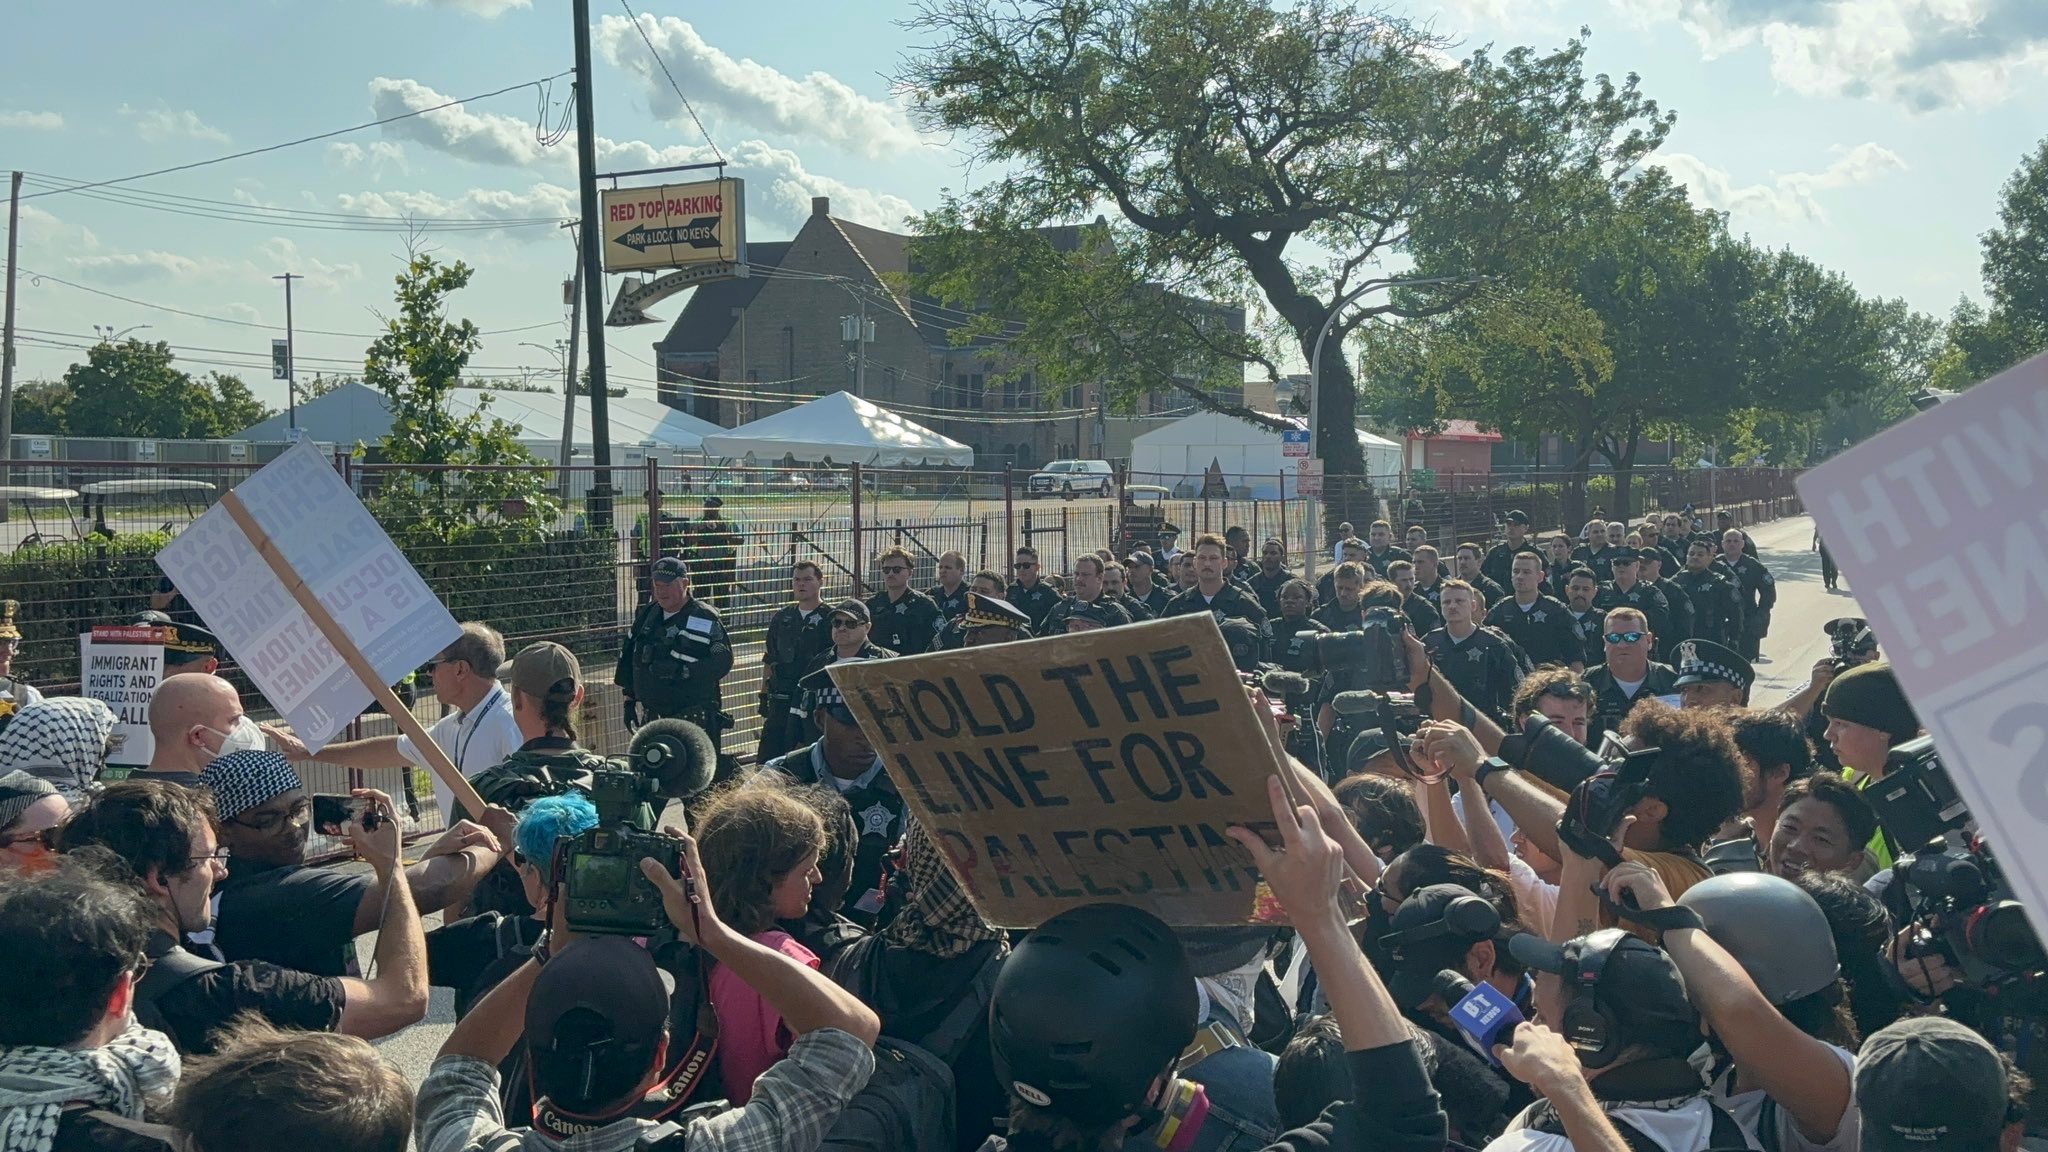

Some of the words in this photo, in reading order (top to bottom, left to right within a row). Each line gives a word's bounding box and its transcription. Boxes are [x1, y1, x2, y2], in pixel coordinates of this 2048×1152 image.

[610, 203, 635, 222] RED
[638, 201, 663, 219] TOP
[667, 194, 723, 216] PARKING
[627, 232, 646, 245] PARK
[646, 234, 652, 243] &
[652, 230, 674, 242] LOCK
[677, 229, 689, 241] NO
[690, 226, 711, 239] KEYS
[123, 630, 152, 638] PALESTINE
[91, 656, 158, 671] IMMIGRANT
[89, 674, 126, 688] RIGHTS
[129, 675, 156, 689] AND
[857, 673, 1036, 744] HOLD
[1041, 645, 1221, 729] THE
[120, 707, 148, 725] ALL
[895, 744, 1070, 816] LINE
[1072, 730, 1234, 805] FOR
[1479, 1005, 1501, 1026] NEWS
[663, 1049, 707, 1100] Canon
[1018, 1085, 1043, 1102] BELL
